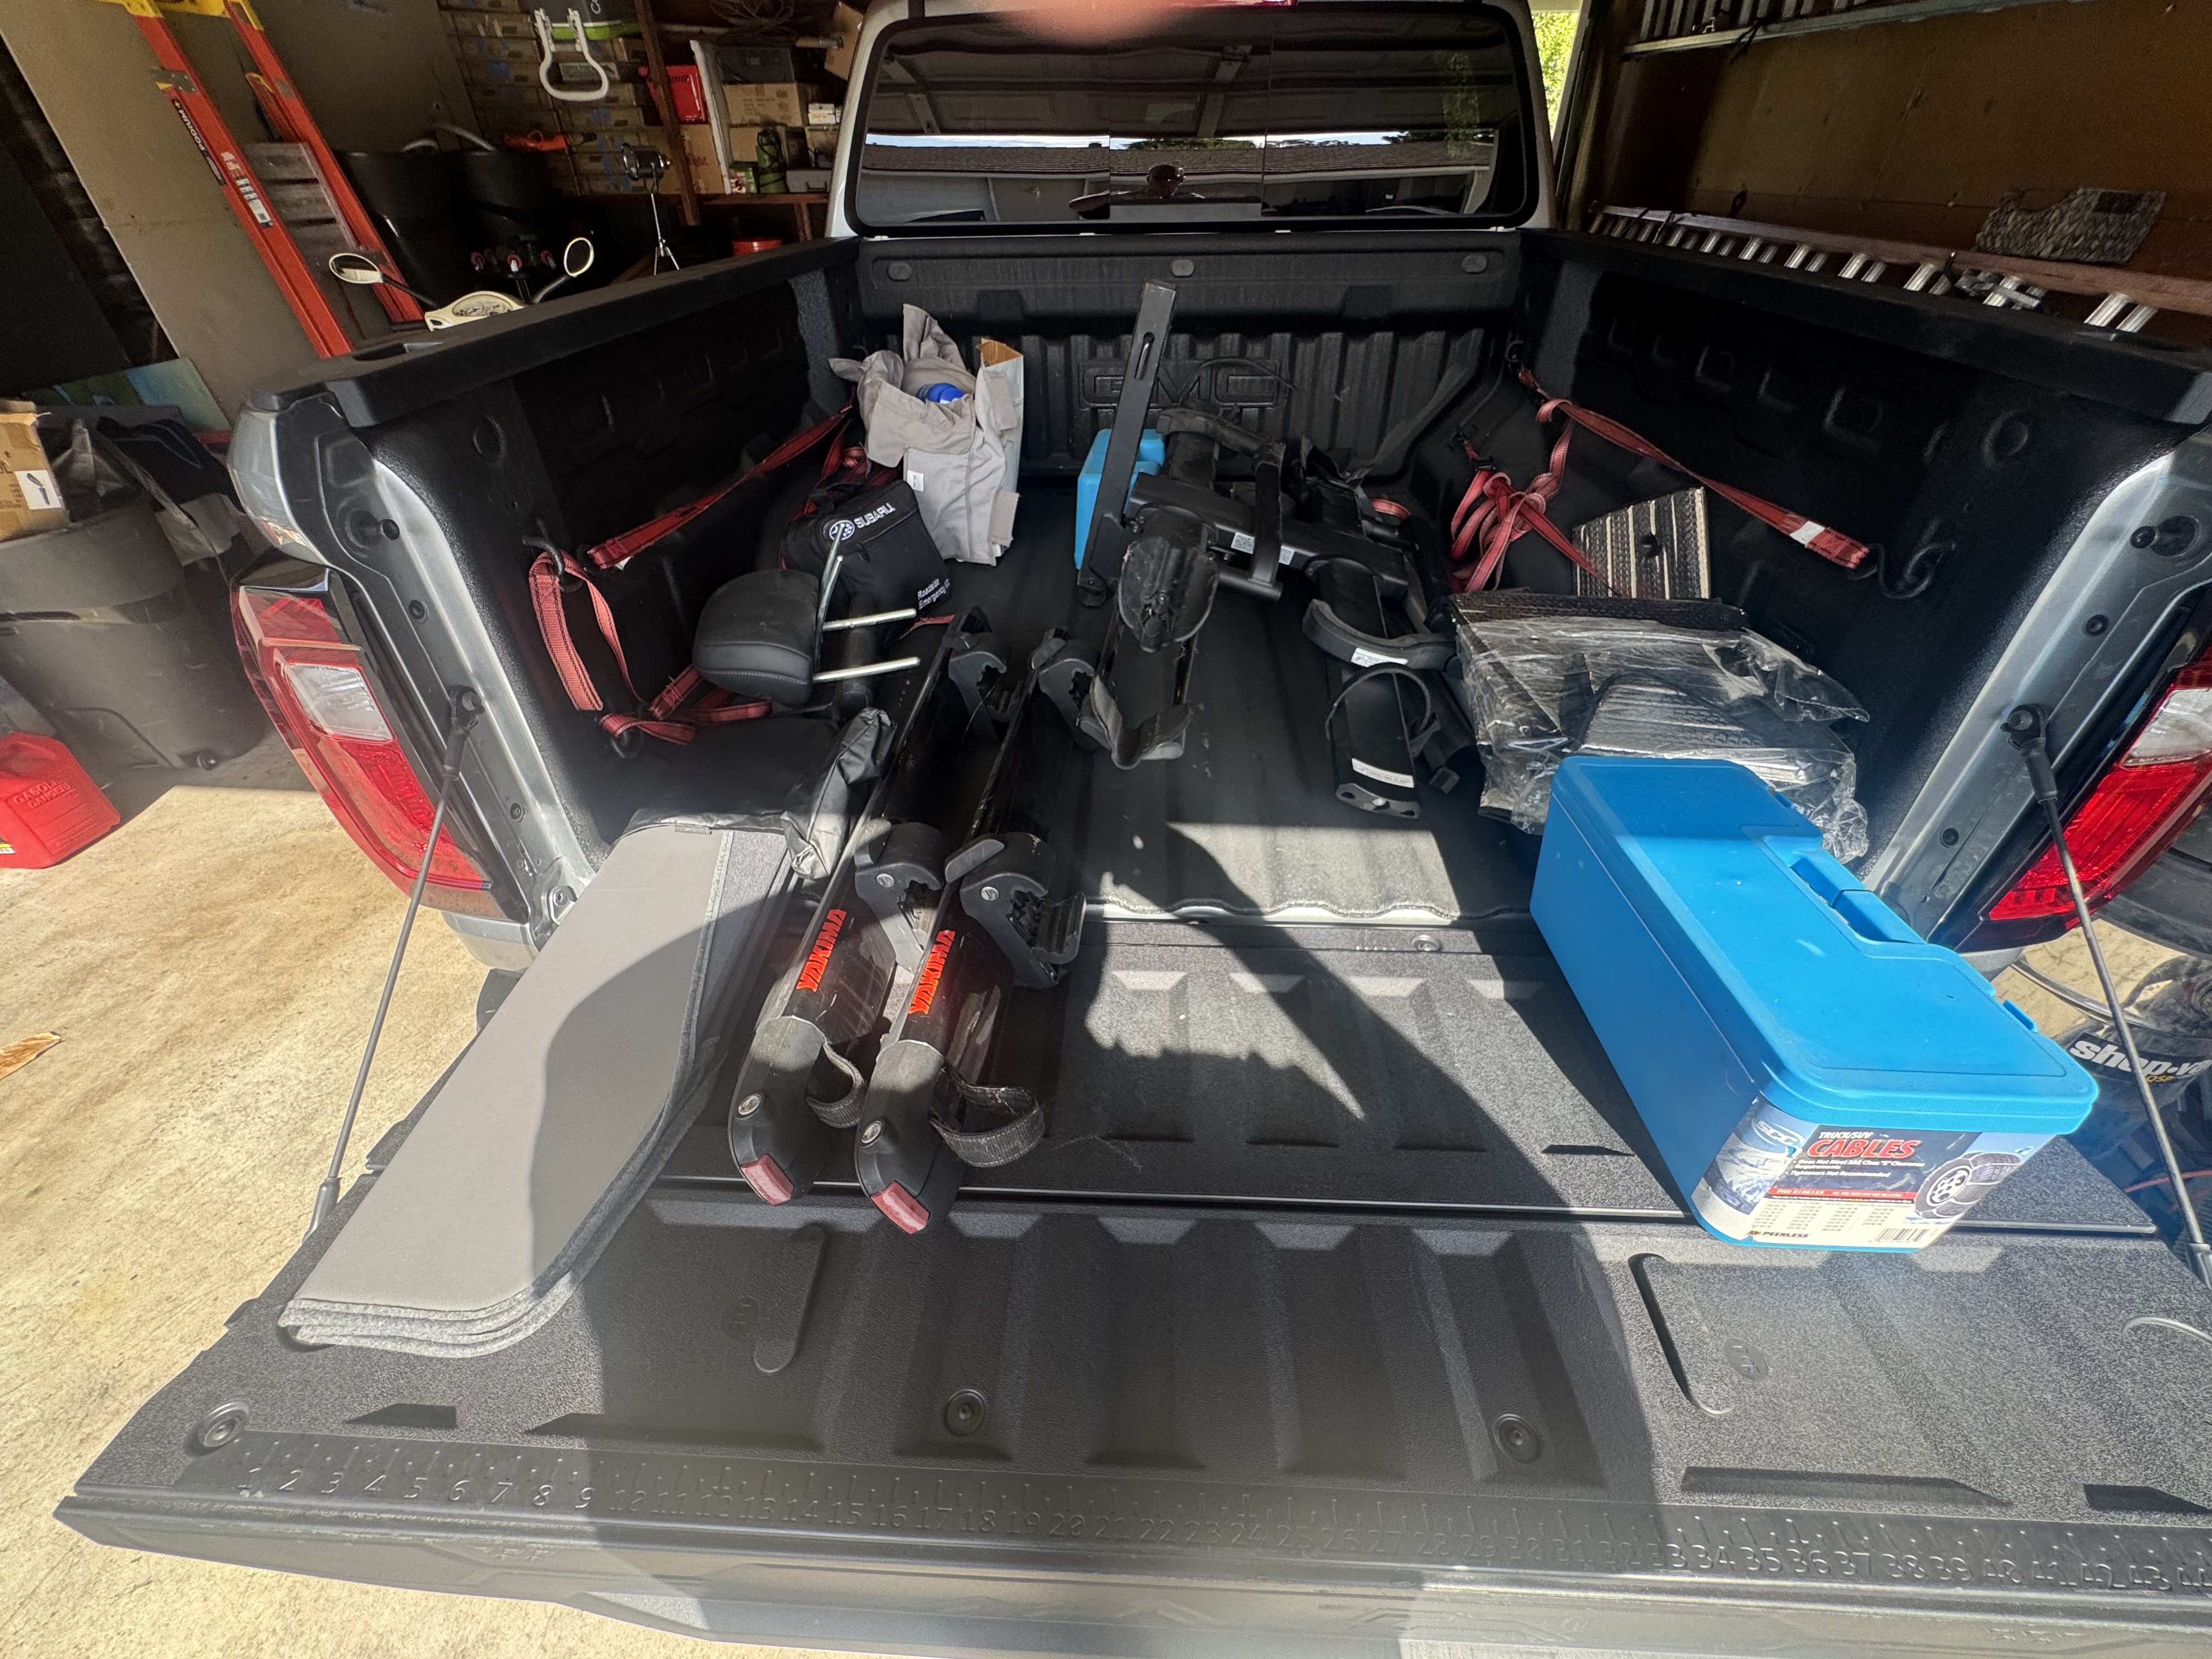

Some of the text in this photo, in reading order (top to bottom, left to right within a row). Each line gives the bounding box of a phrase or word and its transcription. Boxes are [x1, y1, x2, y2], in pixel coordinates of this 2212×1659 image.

[854, 503, 894, 528] SUBARU
[917, 578, 940, 600] Roadside
[918, 586, 946, 610] Emergency
[797, 909, 846, 991] YAKIMA
[909, 930, 955, 1014] YAKIMA
[1807, 1139, 1922, 1159] CABLES
[237, 1467, 261, 1489] 1
[278, 1469, 302, 1492] 2
[320, 1471, 345, 1494] 3
[363, 1474, 387, 1492] 4
[404, 1477, 428, 1498] 5
[448, 1480, 470, 1501] 6
[491, 1481, 513, 1504] 7
[533, 1484, 553, 1506] 8
[575, 1487, 596, 1509] 9
[608, 1489, 646, 1511] 10
[651, 1492, 687, 1515] 11
[695, 1494, 733, 1517] 12
[739, 1497, 776, 1521] 13
[782, 1499, 819, 1522] 14
[826, 1502, 863, 1525] 15
[870, 1504, 908, 1528] 16
[916, 1507, 952, 1530] 17
[960, 1509, 996, 1533] 18
[1005, 1511, 1041, 1534] 19
[1049, 1514, 1085, 1538] 20
[1096, 1517, 1130, 1539] 21
[1141, 1518, 1175, 1542] 22
[1186, 1521, 1221, 1544] 23
[1231, 1523, 1262, 1546] 24
[1277, 1525, 1311, 1548] 25
[1322, 1527, 1359, 1551] 26
[1368, 1530, 1402, 1554] 27
[1693, 1545, 1735, 1570] 34
[1740, 1547, 1782, 1571] 35
[1786, 1548, 1830, 1573] 36
[1834, 1550, 1870, 1576] 37
[1881, 1553, 1927, 1578] 38
[1929, 1556, 1972, 1580] 39
[1984, 1559, 2024, 1584] 40
[2033, 1561, 2077, 1585] 41
[2081, 1562, 2126, 1588] 42
[2130, 1565, 2171, 1590] 43
